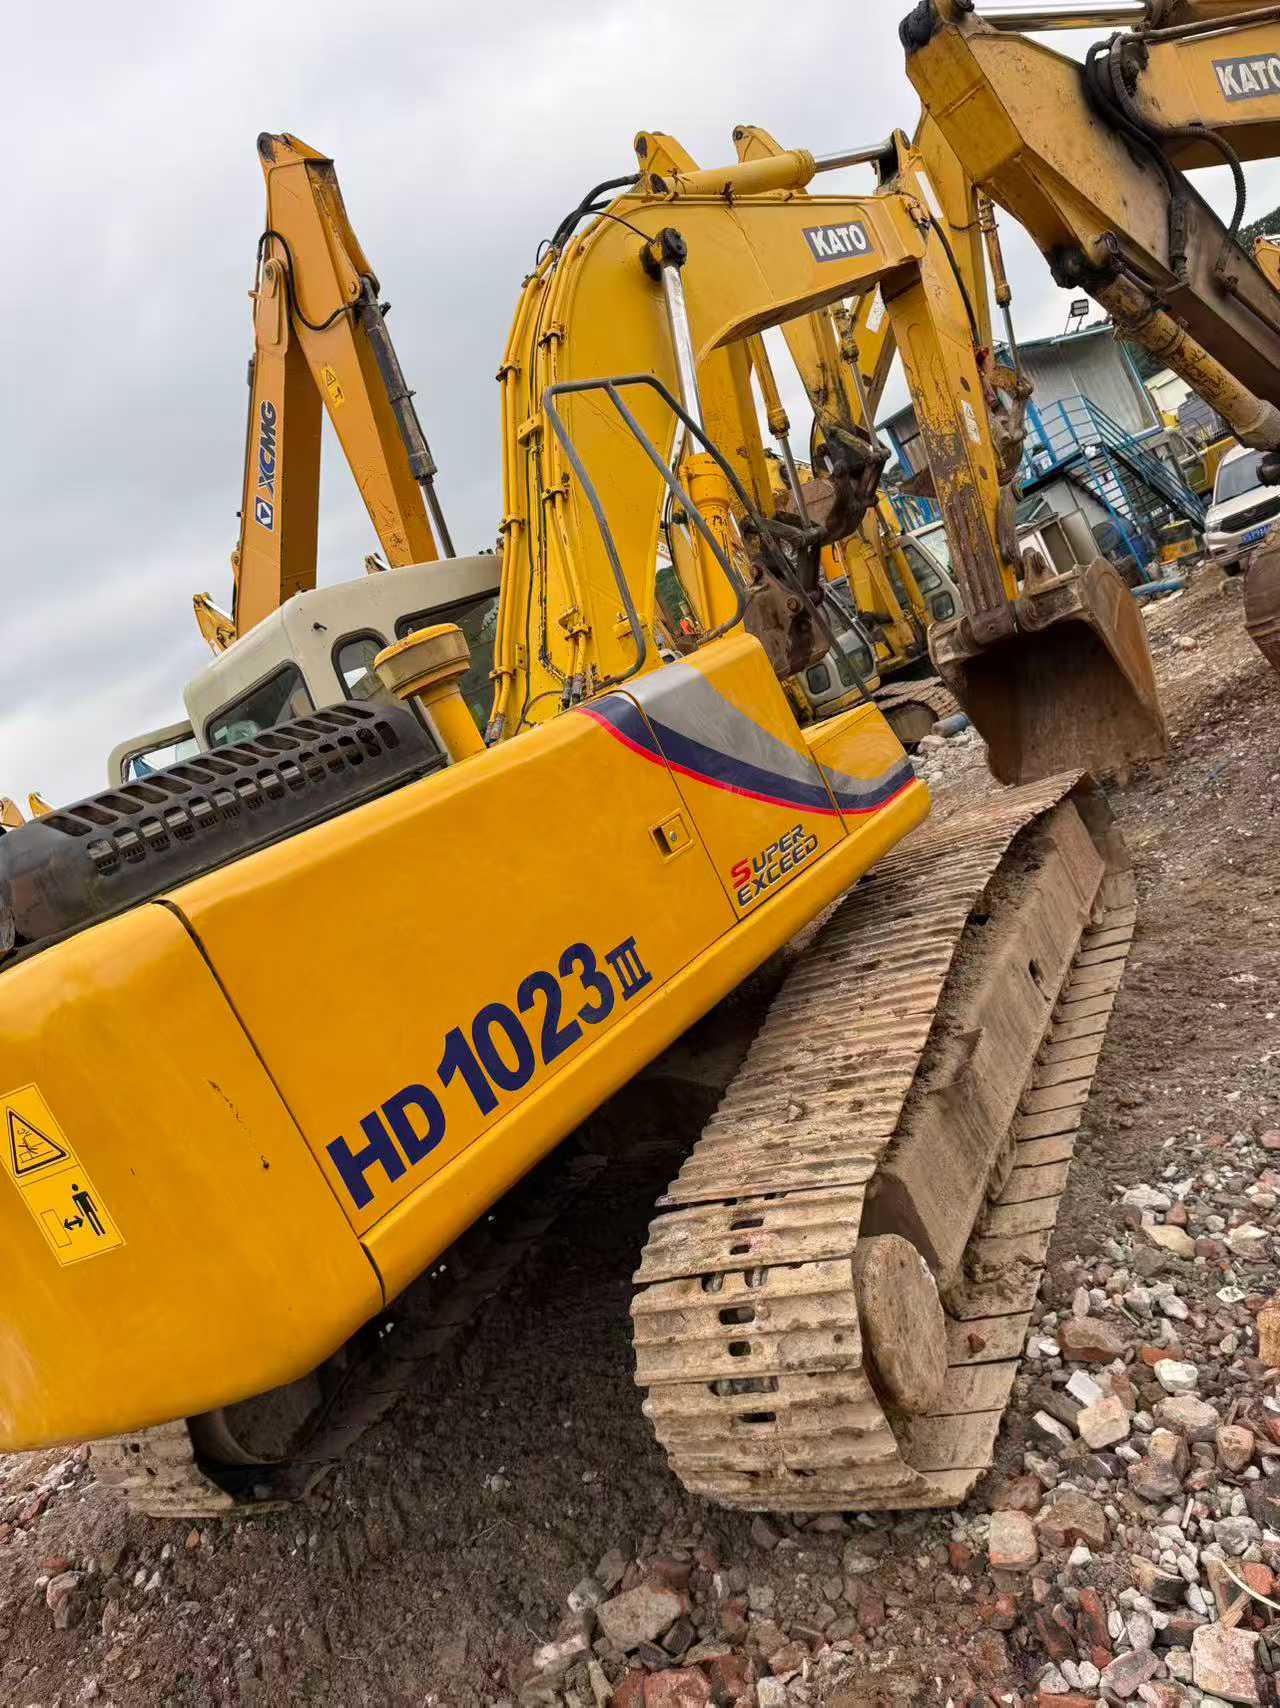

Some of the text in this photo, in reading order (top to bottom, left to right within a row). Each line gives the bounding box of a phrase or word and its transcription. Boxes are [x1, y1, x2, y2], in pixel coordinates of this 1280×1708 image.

[810, 224, 867, 256] KATO
[259, 400, 277, 499] XCMG
[731, 823, 804, 889] SUPER
[737, 834, 818, 907] EXCEED
[326, 1083, 446, 1210] HD
